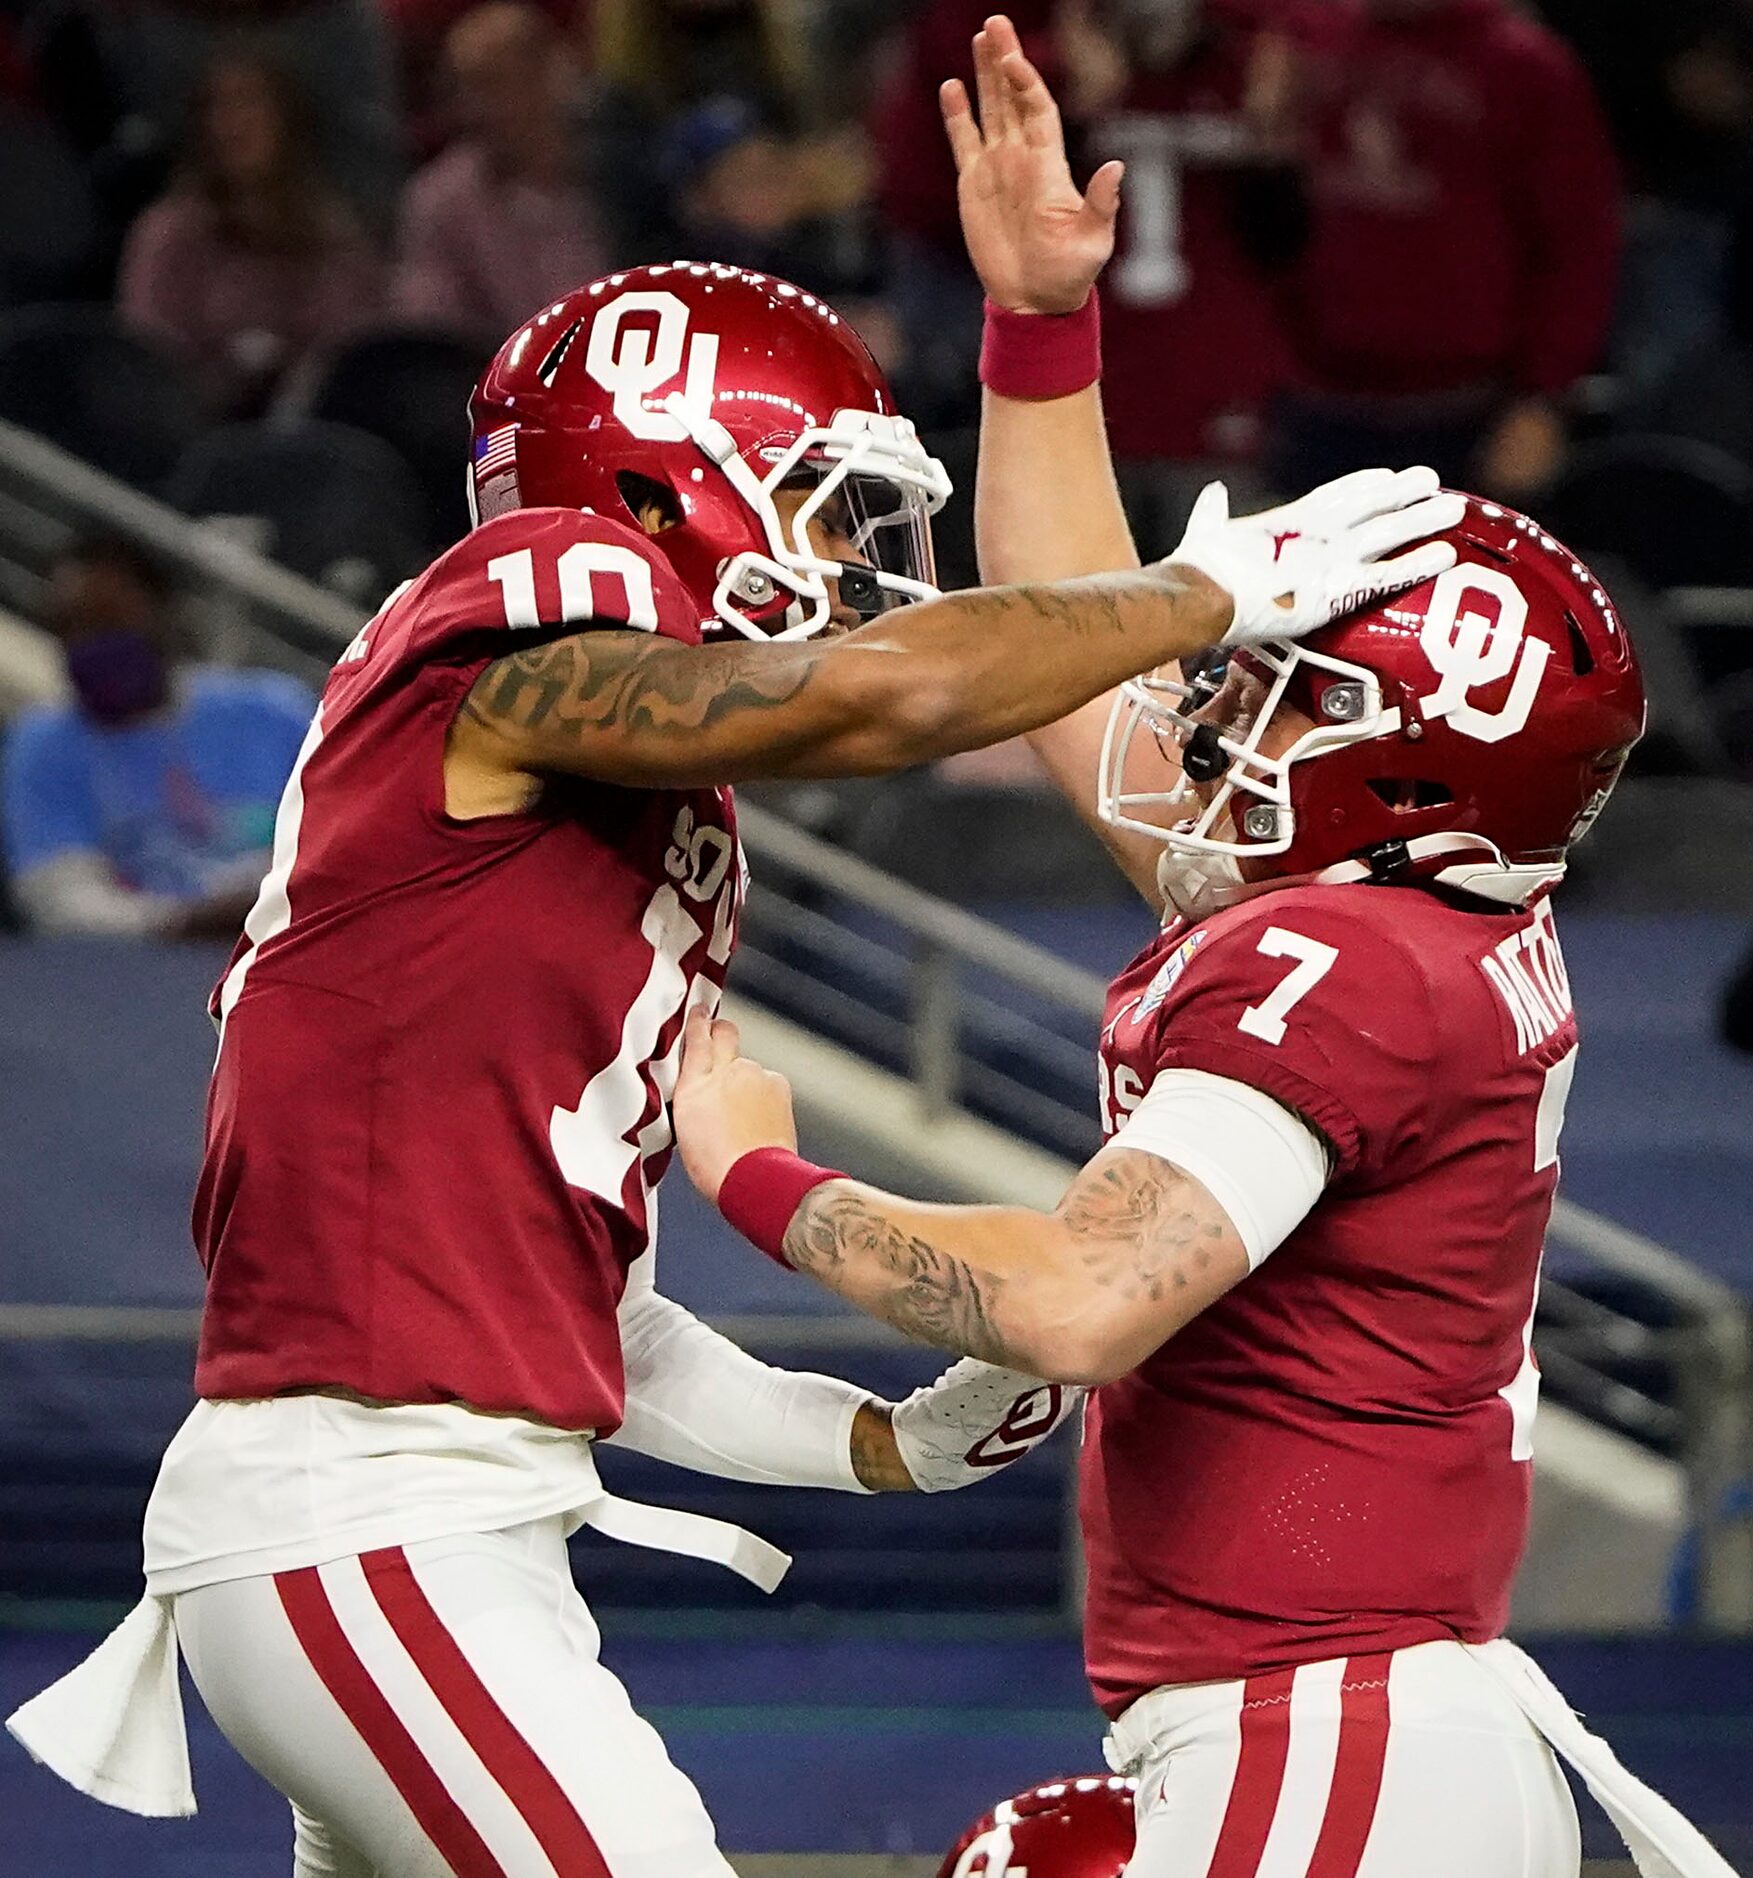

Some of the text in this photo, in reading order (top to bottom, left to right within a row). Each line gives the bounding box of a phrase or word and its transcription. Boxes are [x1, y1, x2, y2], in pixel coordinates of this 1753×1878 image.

[586, 291, 719, 442] OU
[487, 542, 658, 633] 10
[1419, 561, 1553, 743] OU
[1237, 926, 1339, 1046] 7
